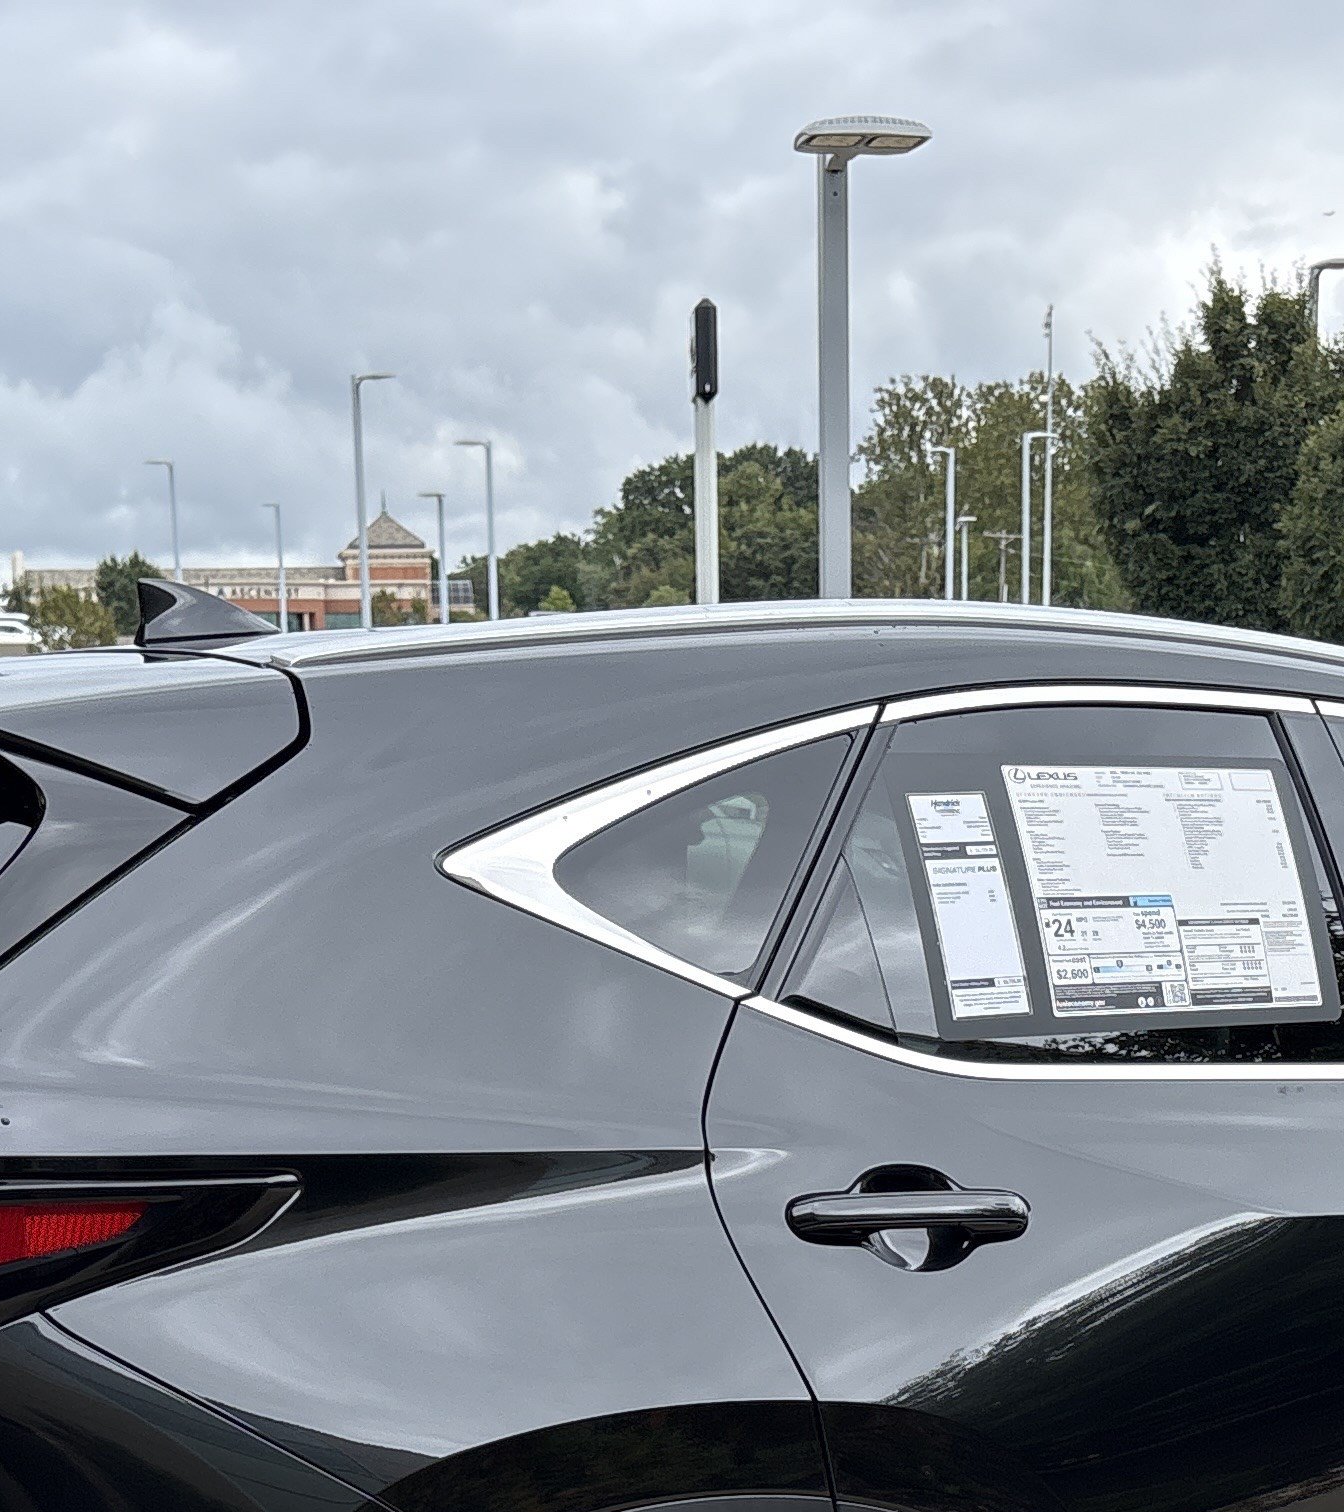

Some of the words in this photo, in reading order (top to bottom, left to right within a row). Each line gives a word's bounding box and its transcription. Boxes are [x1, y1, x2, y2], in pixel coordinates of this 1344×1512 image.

[1027, 772, 1078, 781] LEXUS
[931, 799, 961, 808] Hendrick
[932, 866, 976, 875] SIGNATURE
[977, 865, 998, 873] PLUS
[1051, 918, 1075, 938] 24
[1134, 918, 1167, 930] $4,500
[1056, 968, 1089, 980] $2,600
